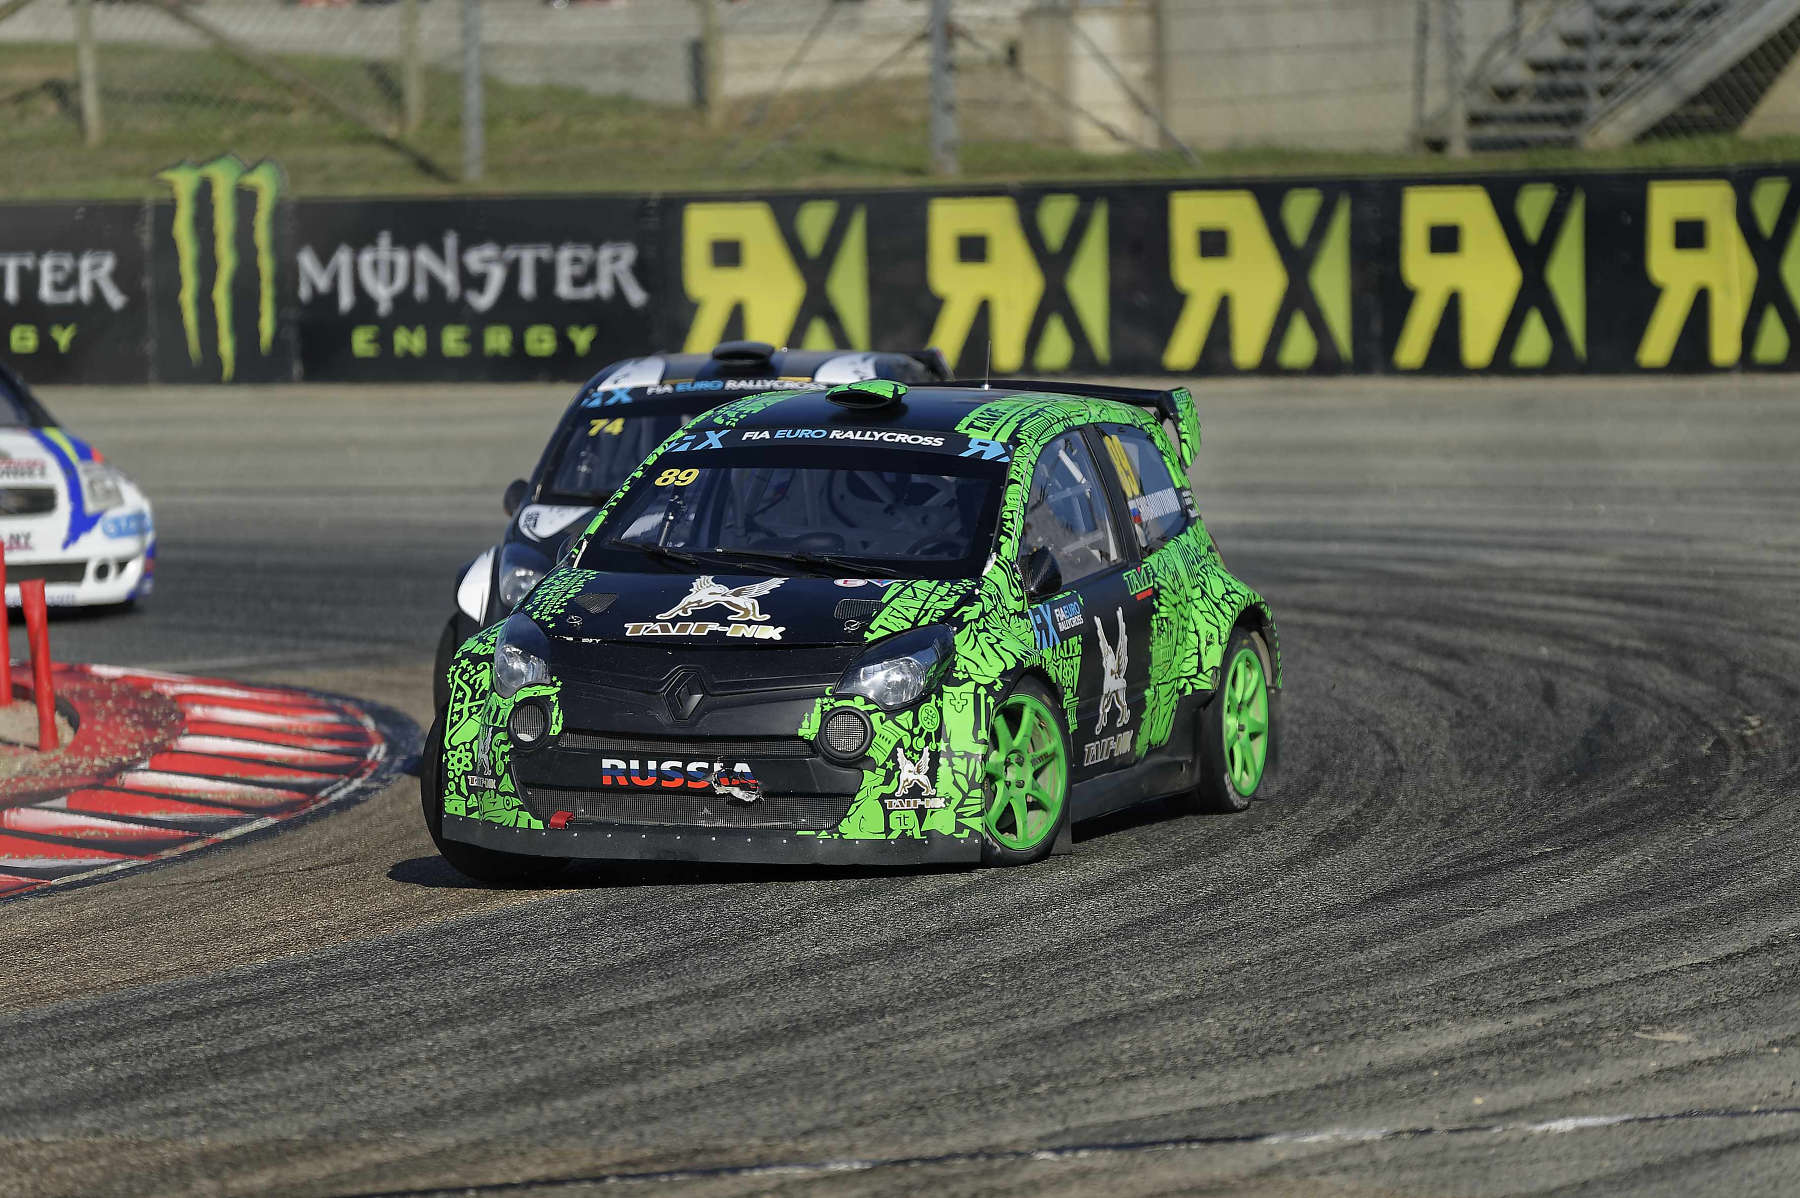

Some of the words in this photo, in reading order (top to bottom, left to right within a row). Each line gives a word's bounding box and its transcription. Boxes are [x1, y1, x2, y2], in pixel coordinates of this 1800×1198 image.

[298, 231, 648, 315] MONSTER
[923, 193, 1112, 372] RX
[1162, 186, 1353, 370] RX
[1393, 183, 1587, 369] RX
[351, 323, 598, 358] ENERGY
[647, 384, 674, 396] FIA
[675, 380, 723, 393] EURO
[724, 379, 828, 391] RALLYCROSS
[587, 417, 625, 437] 74
[742, 431, 771, 442] FIA
[774, 429, 827, 440] EURO
[828, 429, 945, 447] RALLYCROSS
[654, 468, 700, 486] 89
[624, 621, 786, 641] TAIF-NK
[601, 758, 759, 790] RUSSIA
